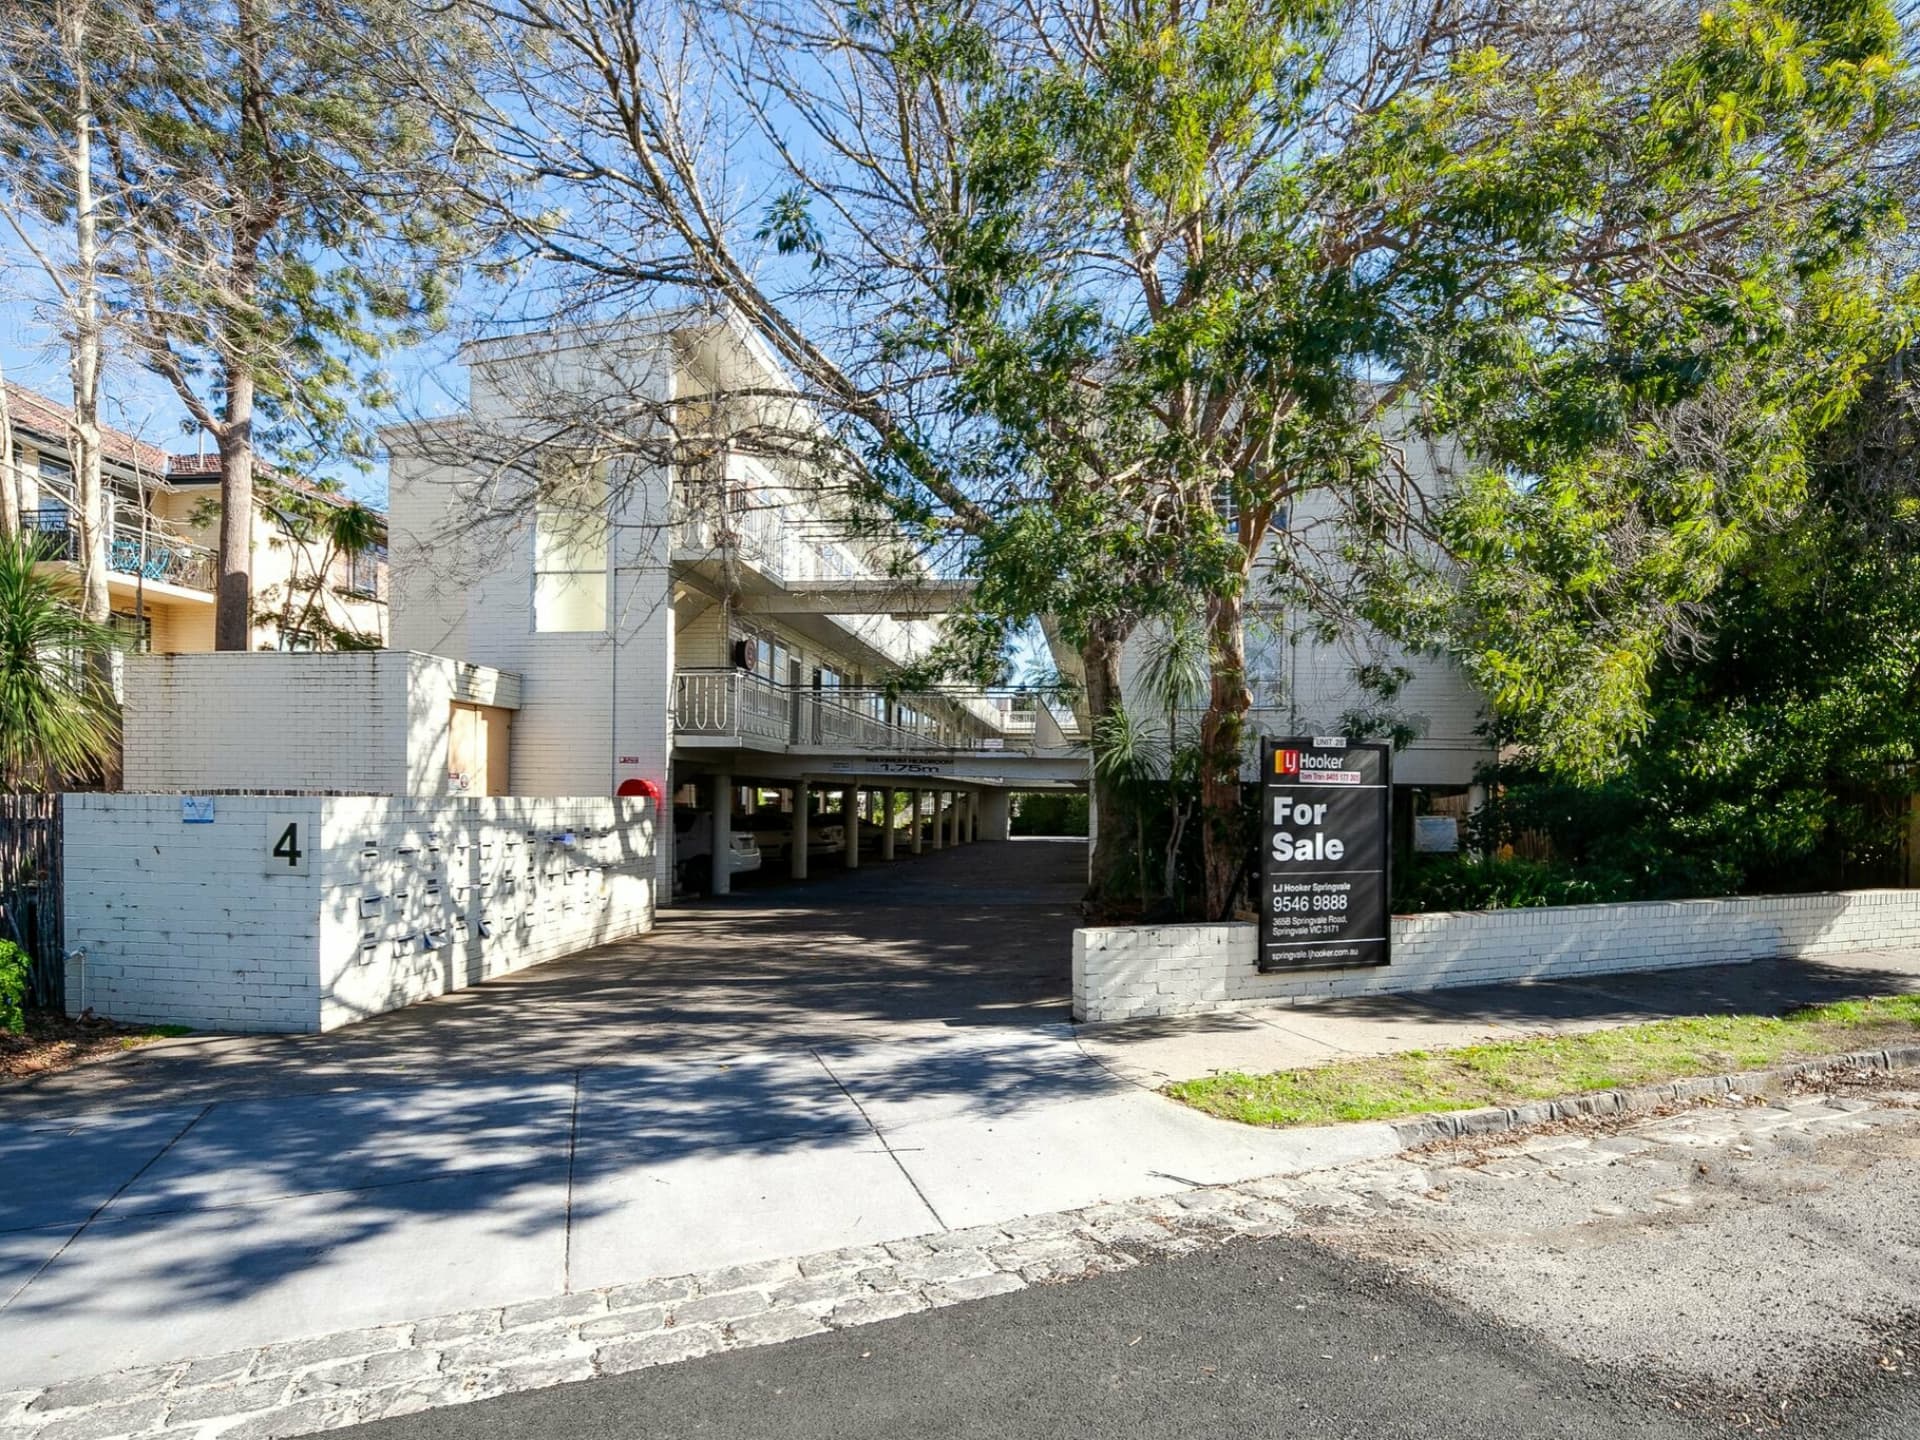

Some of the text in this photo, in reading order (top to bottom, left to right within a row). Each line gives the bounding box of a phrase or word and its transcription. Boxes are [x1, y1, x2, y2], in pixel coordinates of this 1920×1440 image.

[1316, 738, 1332, 746] UNIT
[880, 763, 940, 773] 1.75m
[1285, 752, 1344, 772] LJ Hooker
[1273, 796, 1327, 826] For
[273, 822, 302, 867] 4
[1272, 832, 1345, 861] Sale
[1272, 882, 1351, 893] LJ Hooker Springvale
[1273, 894, 1347, 912] 9546 9888
[1292, 916, 1327, 926] Springvale
[1272, 924, 1340, 937] Springvale VIC 3171
